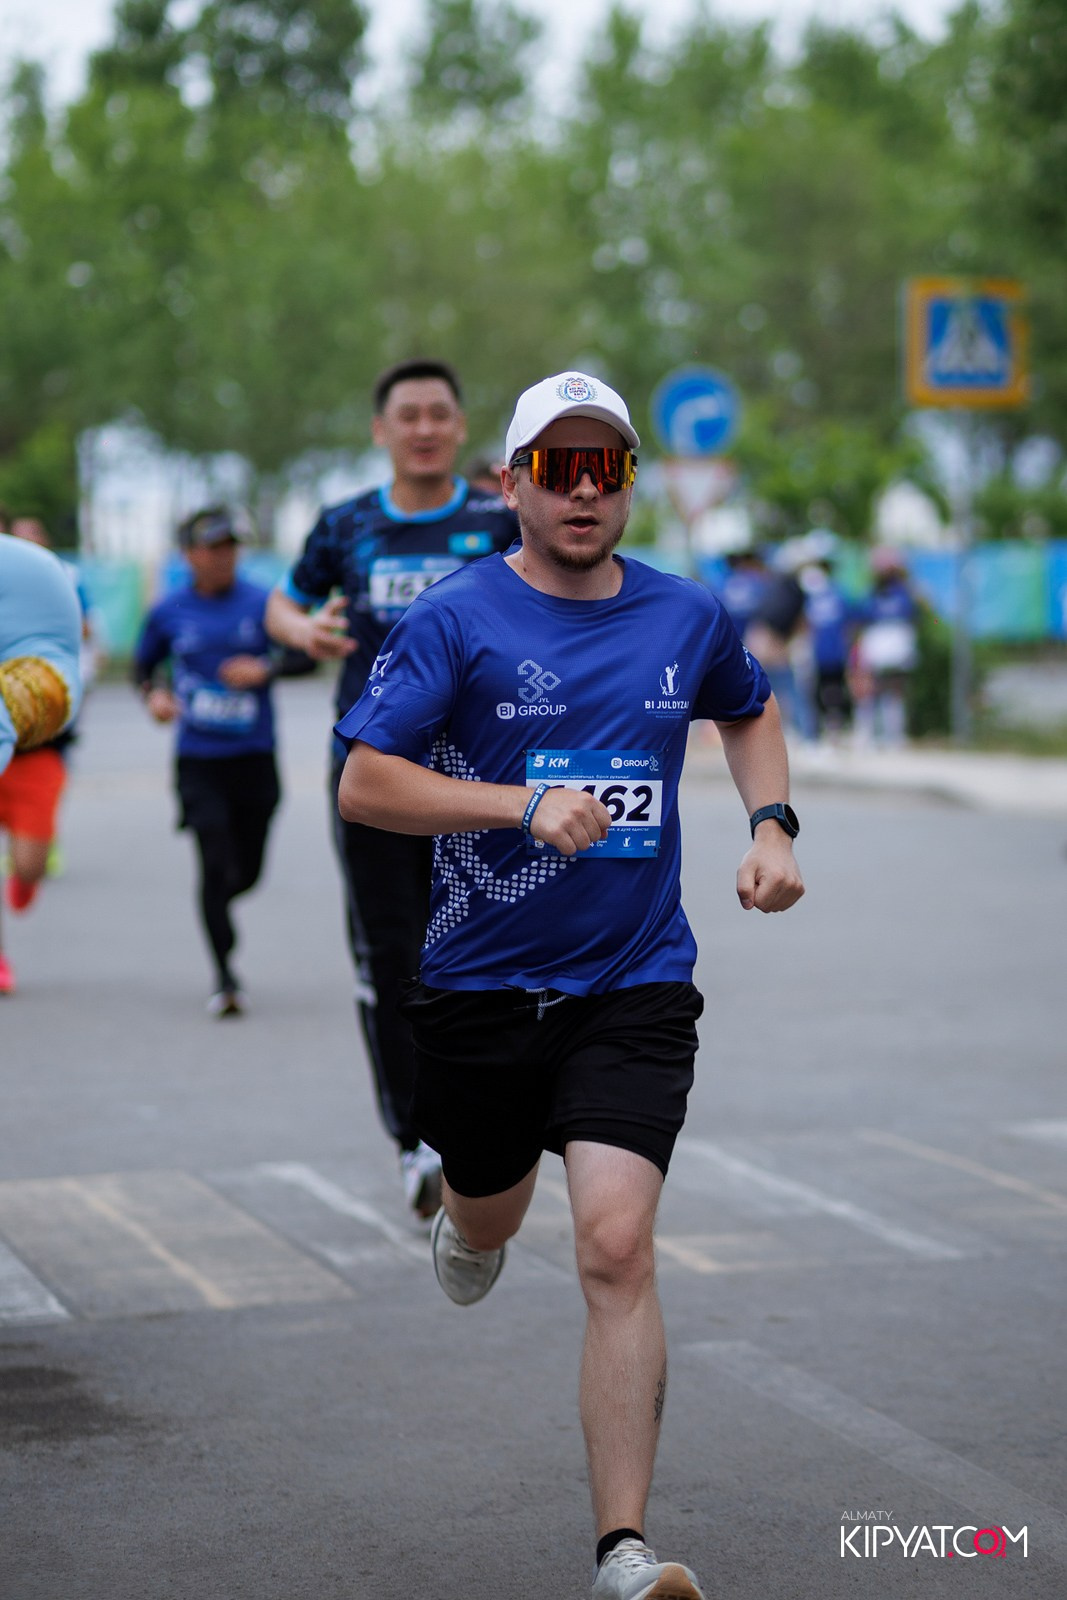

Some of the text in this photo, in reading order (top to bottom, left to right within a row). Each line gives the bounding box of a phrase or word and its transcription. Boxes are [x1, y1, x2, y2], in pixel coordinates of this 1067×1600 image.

[644, 700, 654, 709] BI
[500, 704, 567, 716] BI GROUP
[533, 755, 569, 768] 5 KM
[623, 759, 649, 767] GROUP
